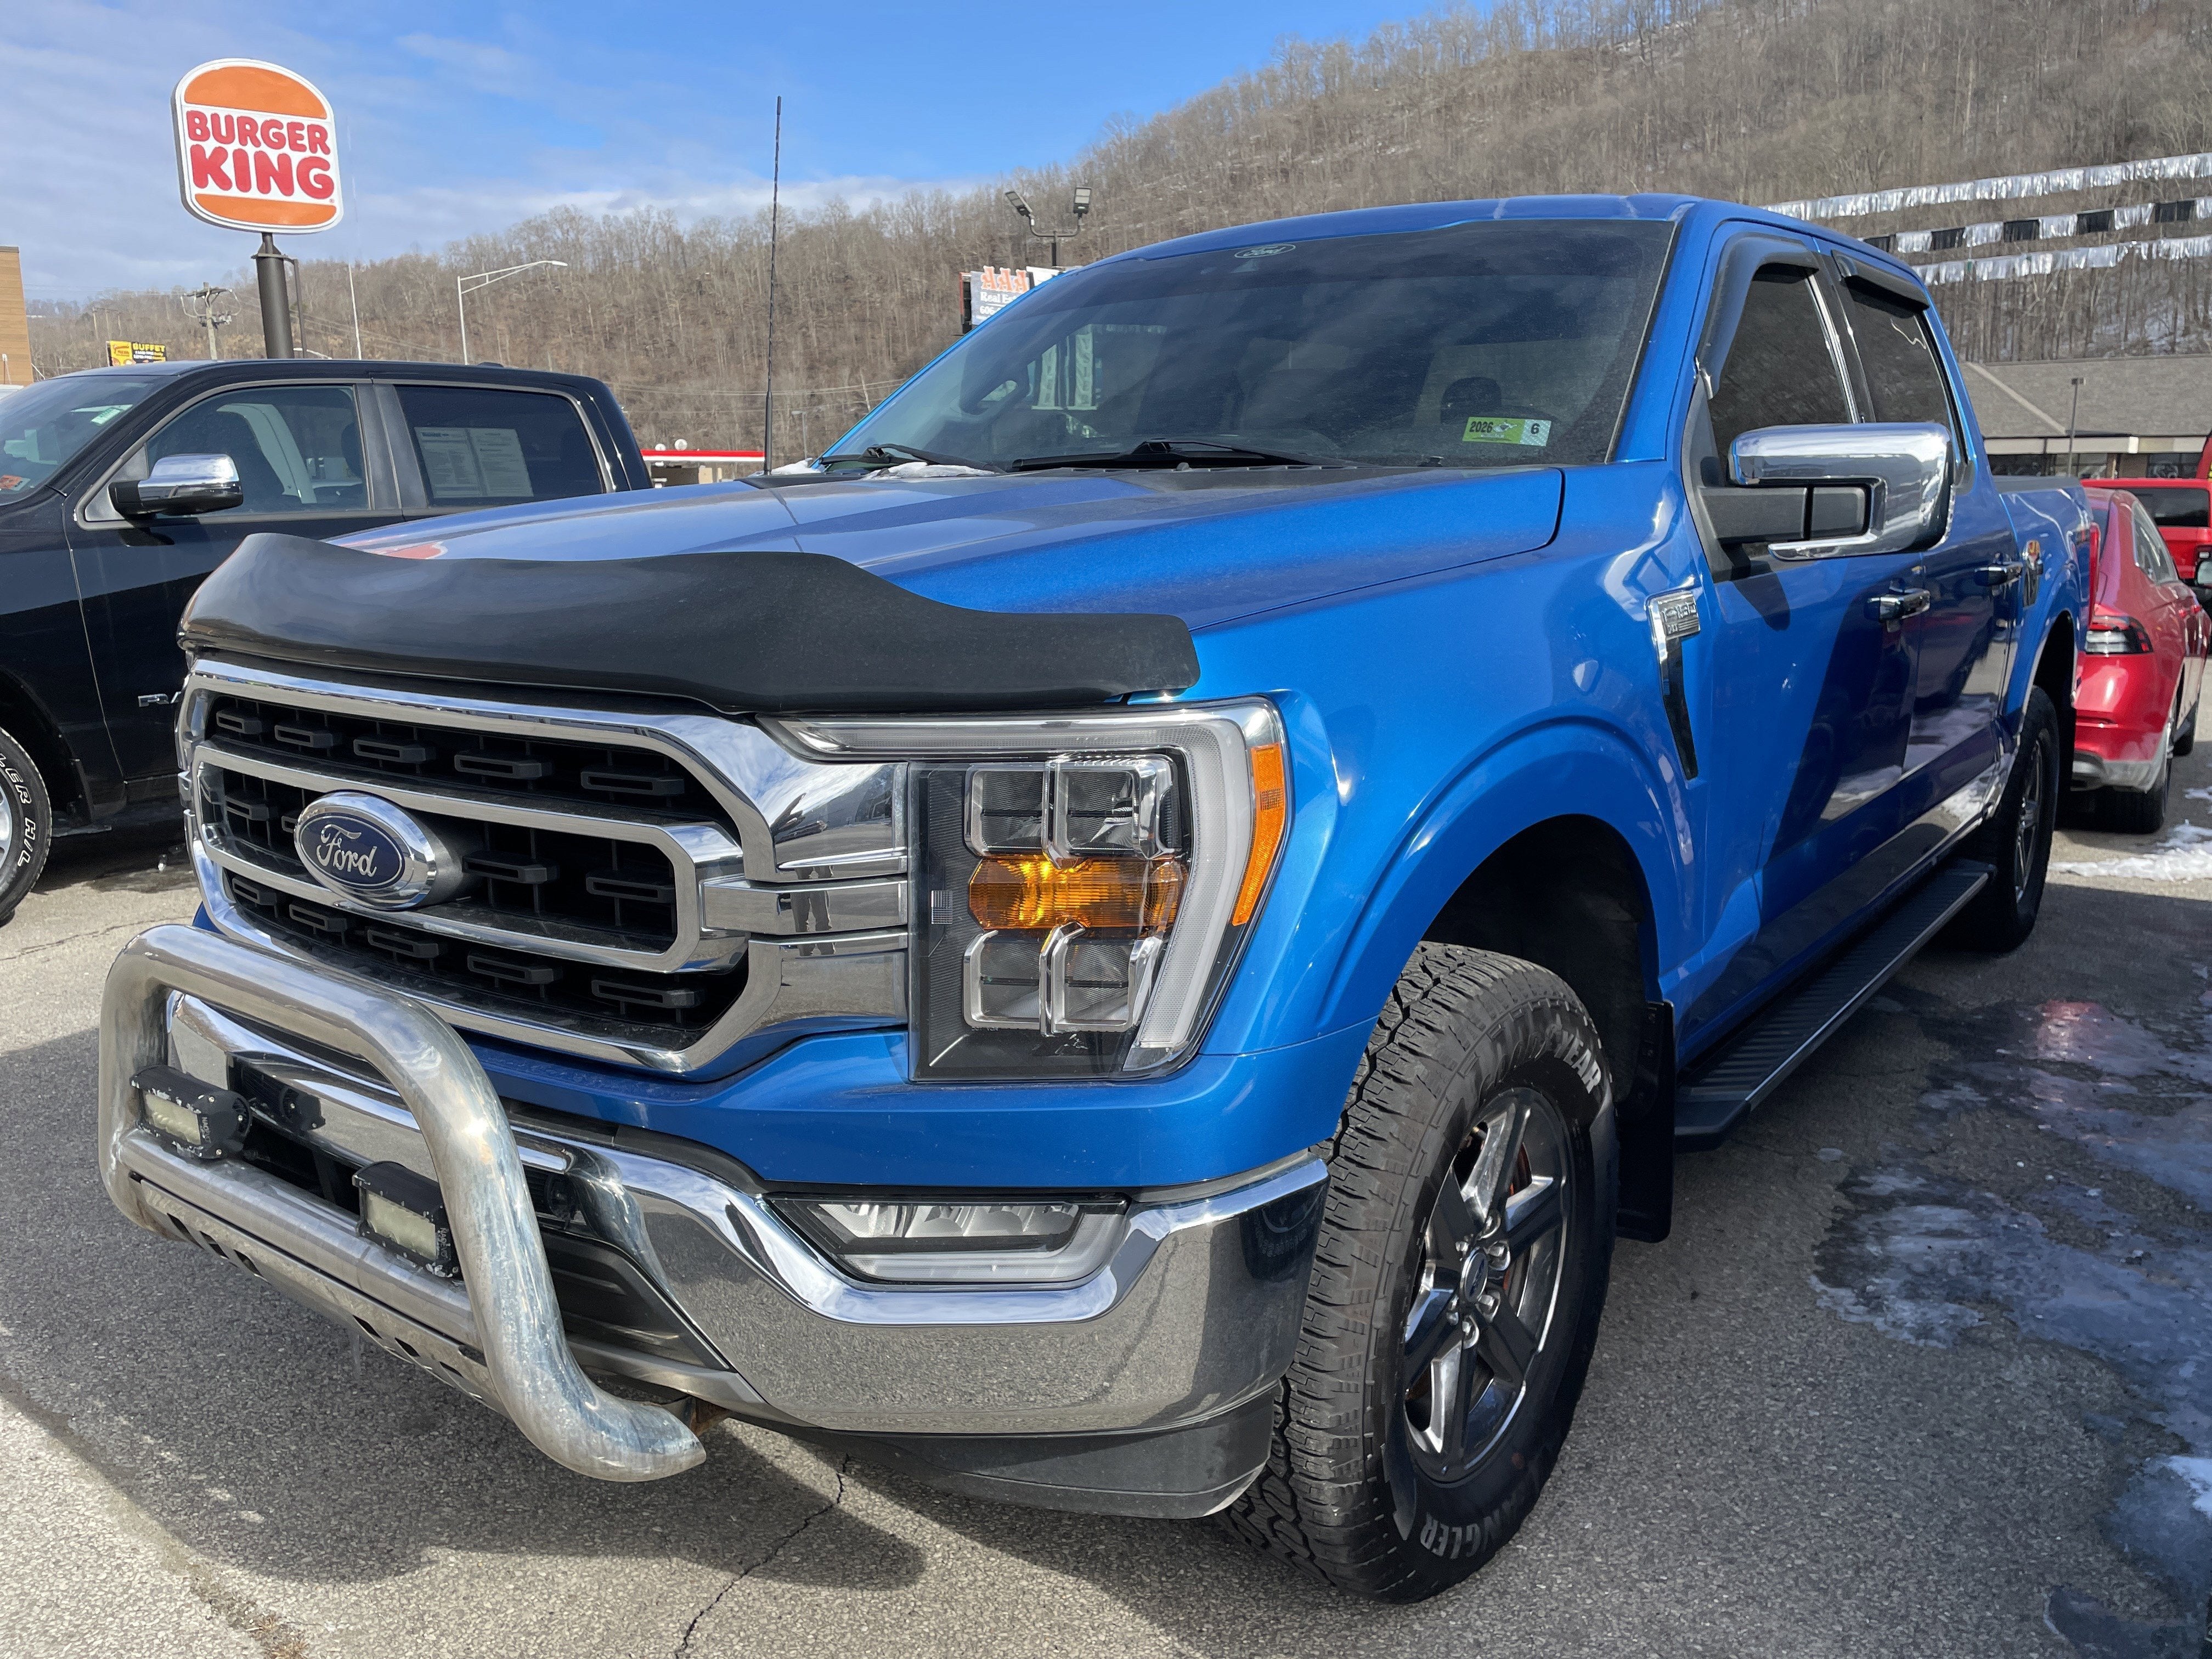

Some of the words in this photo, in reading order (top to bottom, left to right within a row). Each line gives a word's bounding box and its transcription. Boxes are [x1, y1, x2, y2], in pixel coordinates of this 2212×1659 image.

[187, 110, 330, 155] BURGER
[190, 144, 334, 199] KING
[980, 291, 1001, 303] Real
[132, 343, 165, 352] BUFFET
[1469, 421, 1493, 433] 2026
[1530, 422, 1540, 435] 6
[317, 824, 377, 877] Ford
